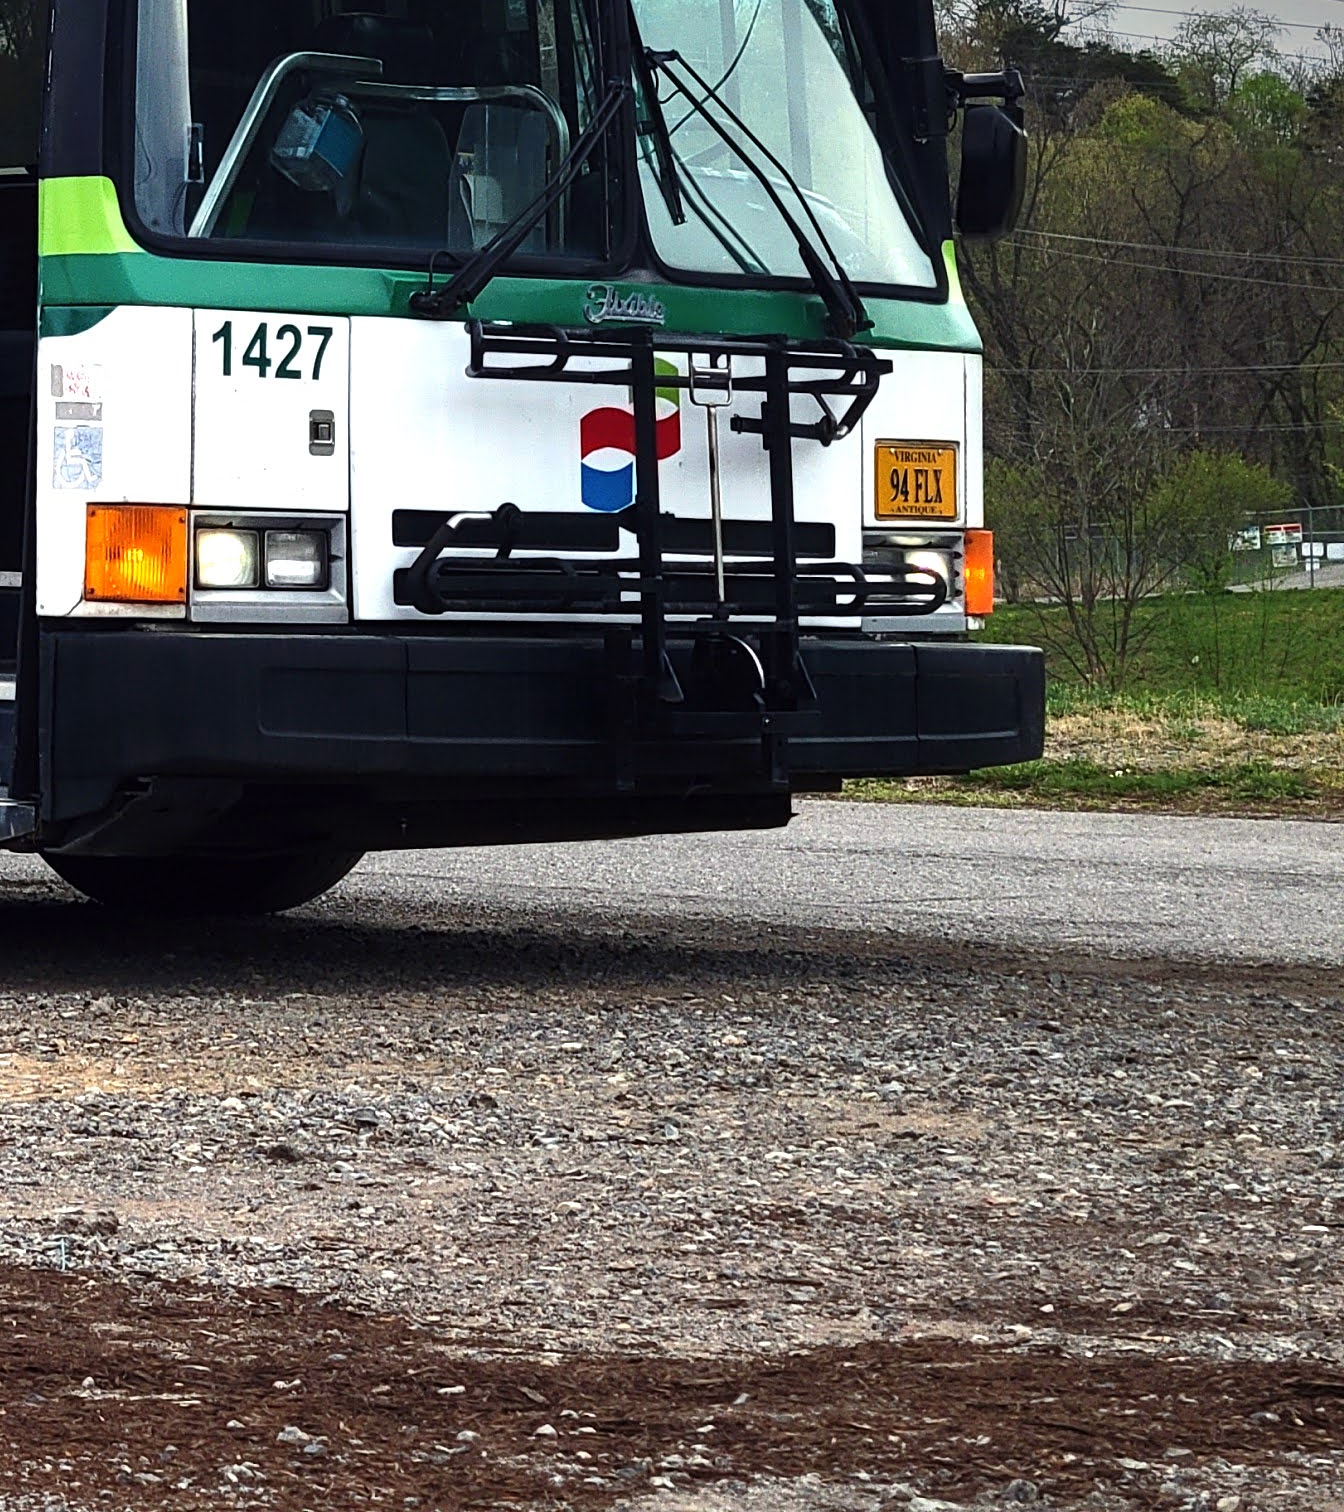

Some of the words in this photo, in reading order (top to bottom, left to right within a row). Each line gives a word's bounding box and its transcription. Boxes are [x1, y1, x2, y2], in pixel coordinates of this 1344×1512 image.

[212, 320, 333, 381] 1427
[894, 450, 937, 463] VIRGINIA
[890, 468, 909, 503] 94
[914, 469, 943, 504] FLX
[896, 505, 938, 515] ANTIQUE
